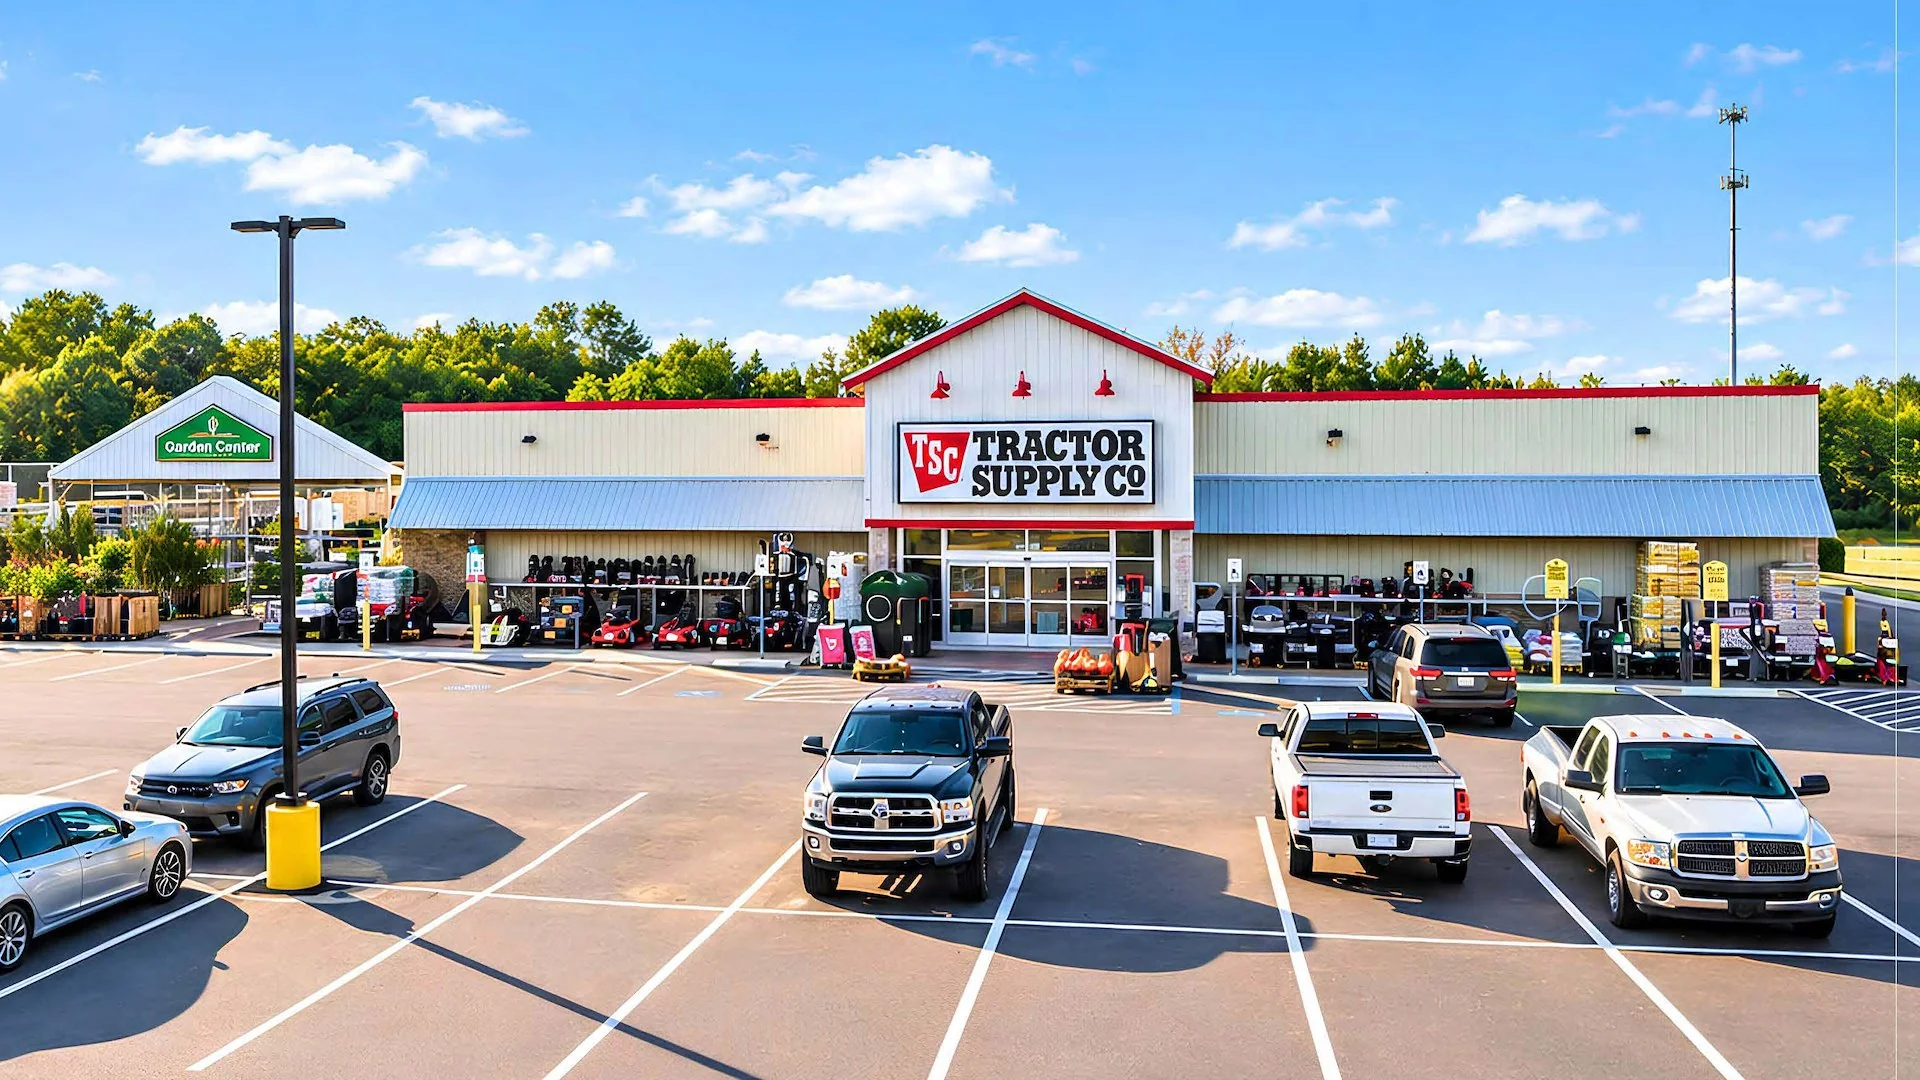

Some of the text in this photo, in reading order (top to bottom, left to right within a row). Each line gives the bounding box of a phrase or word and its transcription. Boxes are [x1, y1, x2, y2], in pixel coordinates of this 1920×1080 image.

[911, 433, 959, 482] TSC
[972, 429, 1145, 462] TRACTOR
[972, 465, 1101, 497] SUPPLY
